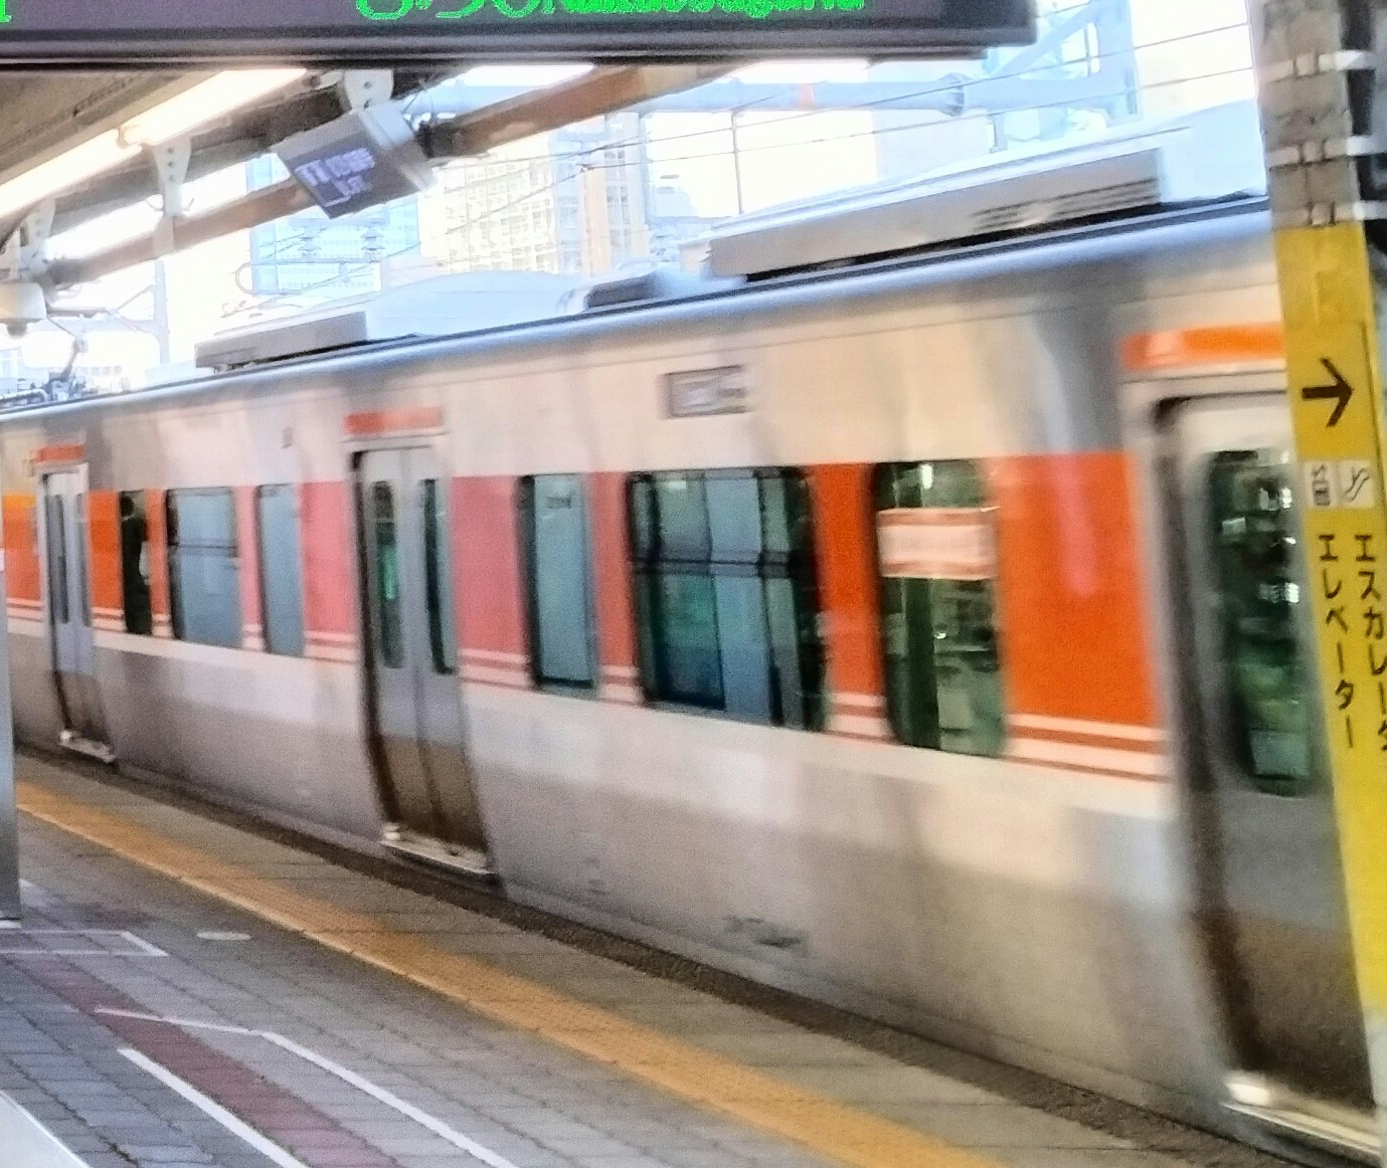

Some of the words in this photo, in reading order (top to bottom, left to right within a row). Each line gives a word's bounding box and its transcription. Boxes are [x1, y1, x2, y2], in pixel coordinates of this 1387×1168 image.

[1317, 534, 1355, 750] エレベーター
